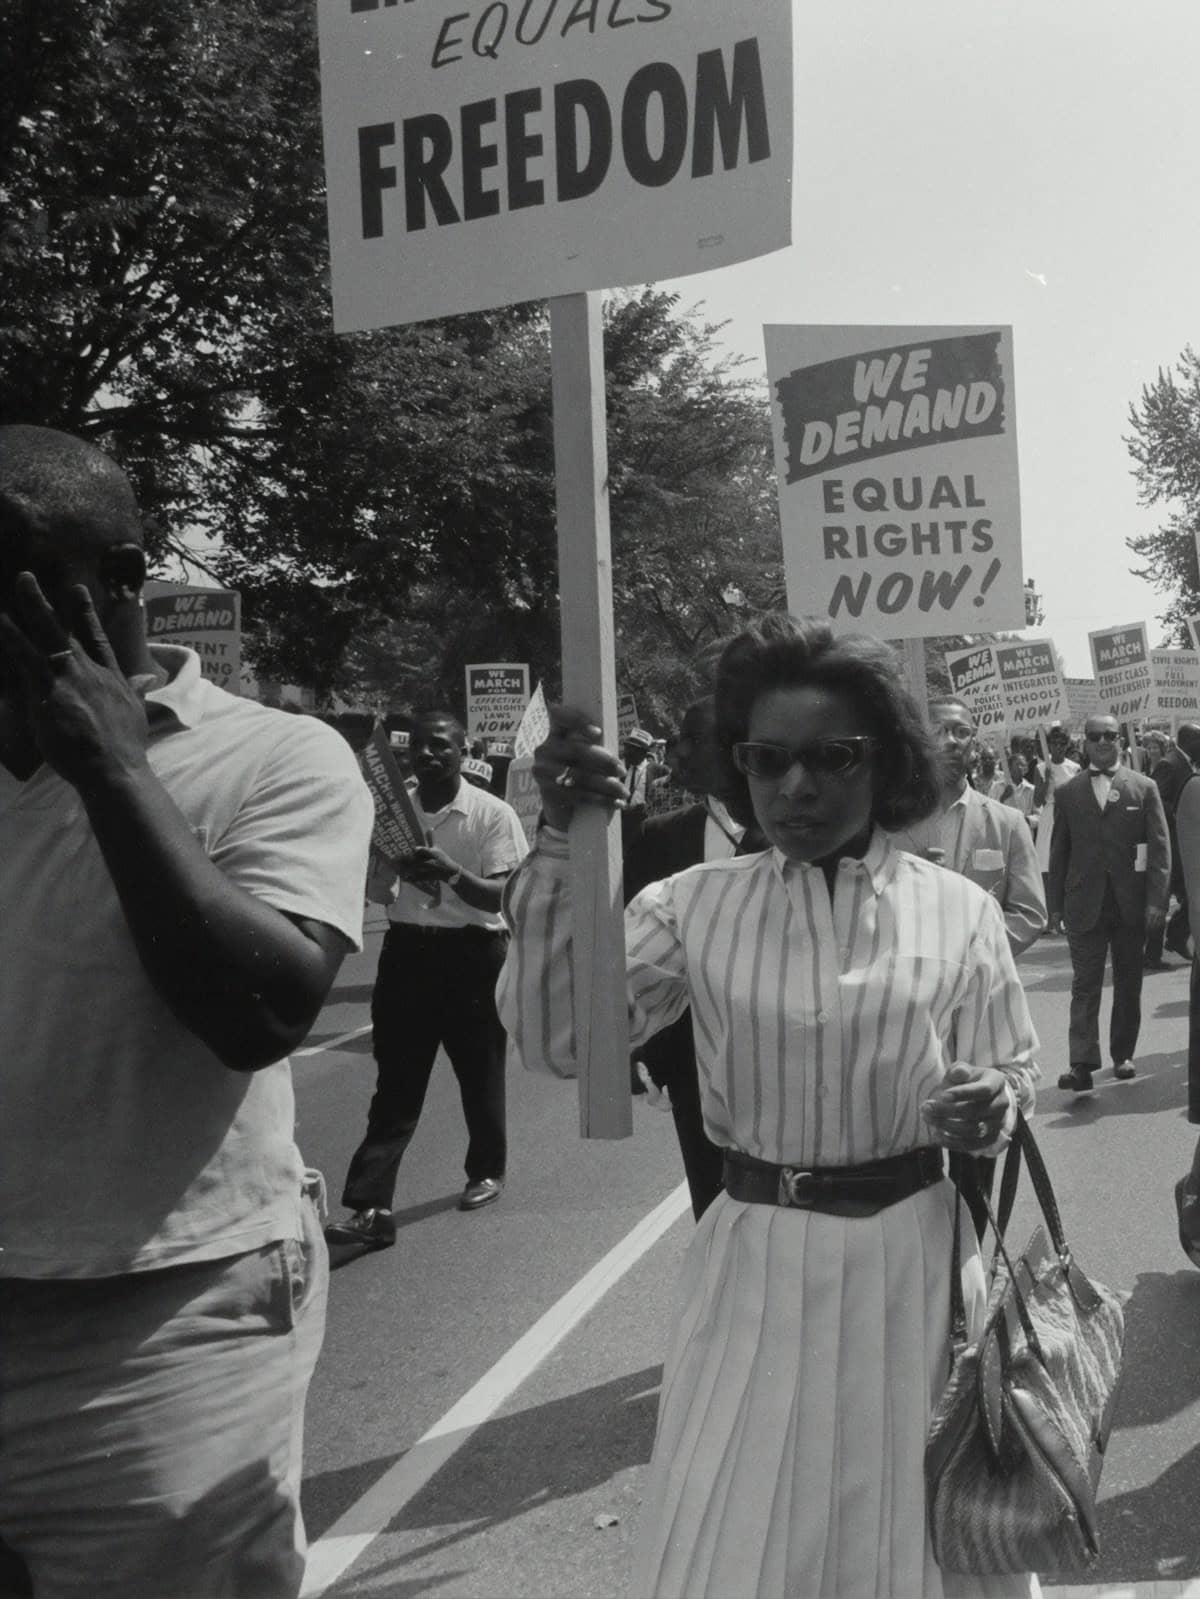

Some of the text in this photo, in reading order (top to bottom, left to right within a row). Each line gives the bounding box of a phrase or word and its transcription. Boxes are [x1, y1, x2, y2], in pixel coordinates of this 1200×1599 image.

[357, 36, 771, 240] FREEDOM
[853, 349, 932, 403] WE
[799, 381, 997, 466] DEMAND
[822, 474, 986, 514] EQUAL
[822, 518, 994, 560] RIGHTS
[828, 557, 1002, 619] NOW!
[173, 594, 208, 613] WE
[151, 609, 233, 633] DEMAND
[968, 650, 991, 669] WE
[1099, 641, 1142, 660] MARCH
[1003, 655, 1051, 672] MARCH
[474, 678, 520, 689] MARCH
[488, 670, 505, 678] WE
[957, 661, 996, 688] DEMA
[1002, 675, 1058, 693] INTEGRATED
[1098, 665, 1149, 687] FIRST CLASS
[963, 683, 999, 697] AN EN
[1005, 687, 1061, 706] SCHOOLS
[1098, 677, 1152, 700] CITIZENSHIP
[469, 704, 527, 713] CIVIL RIGHTS
[974, 693, 1001, 706] POLICE
[1109, 693, 1150, 716] NOW!
[1157, 696, 1198, 709] REEDOM
[483, 712, 511, 720] LAWS
[971, 710, 1005, 727] NOW
[1013, 699, 1060, 722] NOW!
[364, 742, 394, 793] MARCH
[387, 815, 416, 859] FREEDO
